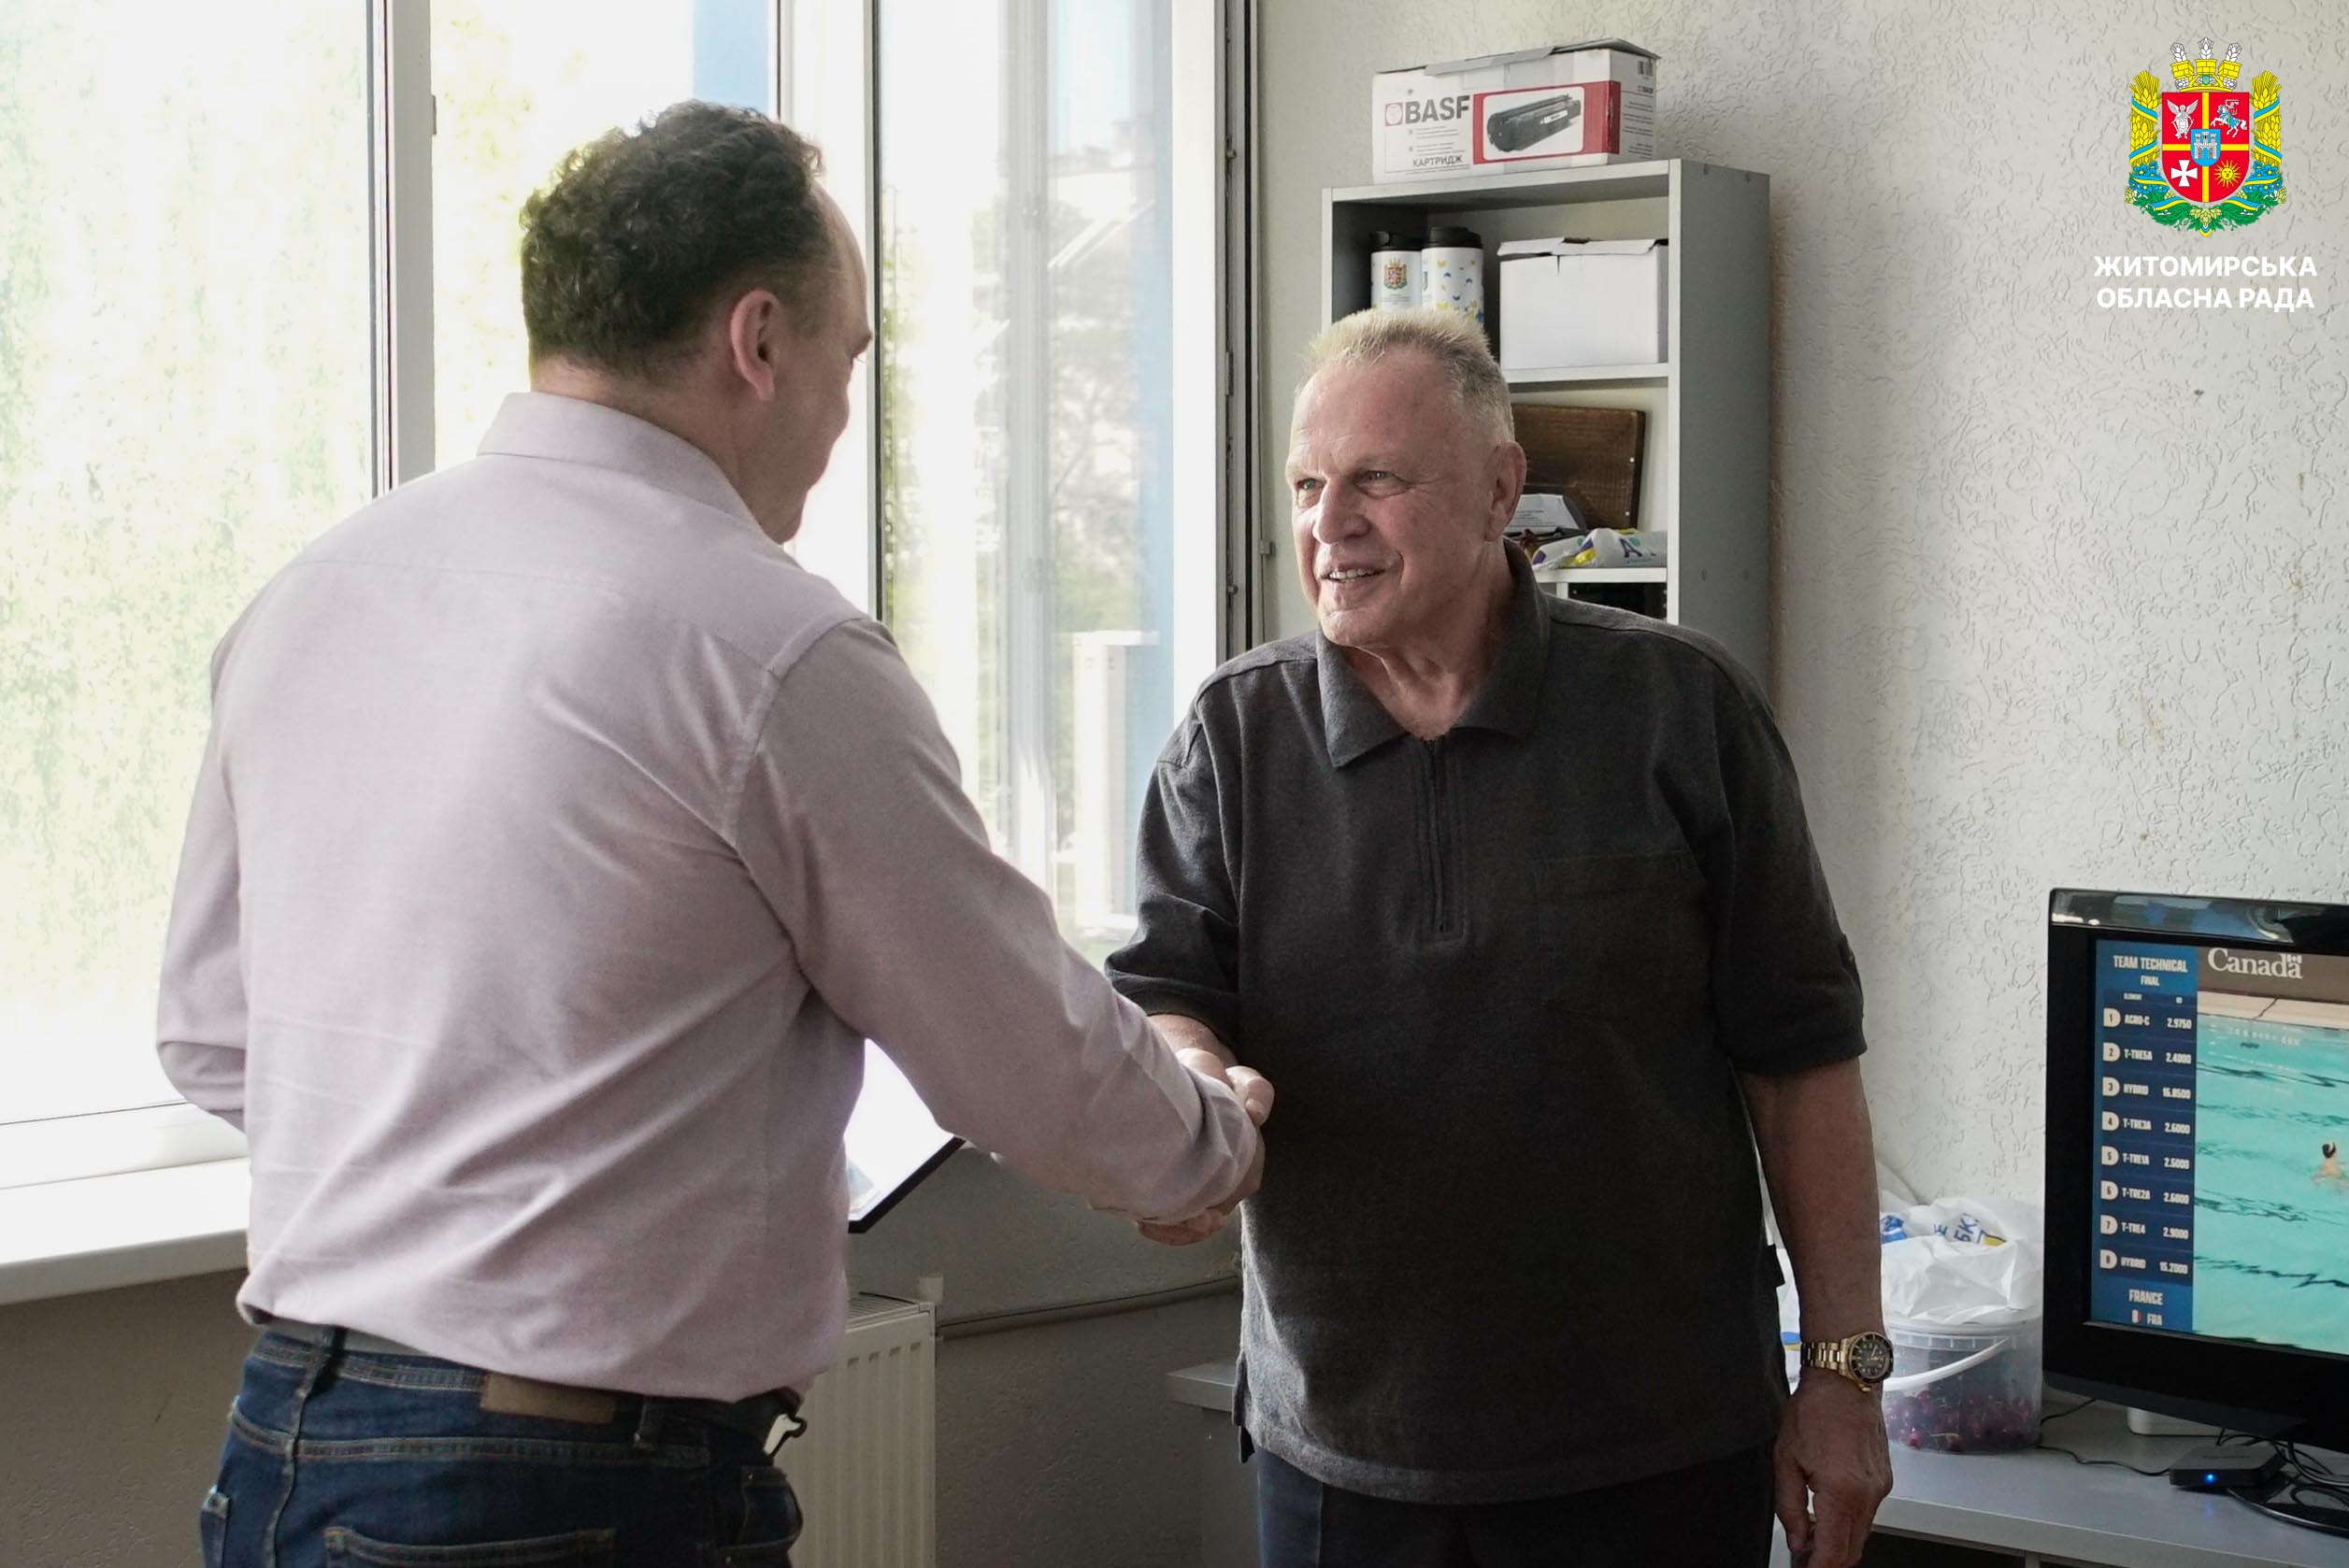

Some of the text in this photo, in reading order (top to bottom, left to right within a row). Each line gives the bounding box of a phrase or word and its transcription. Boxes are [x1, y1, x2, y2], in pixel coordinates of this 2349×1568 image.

[1405, 94, 1470, 124] BASF
[1412, 154, 1464, 167] КАРТРИДЖ
[2113, 955, 2188, 973] TEAM TECHNICAL
[2207, 947, 2304, 979] Canada
[2128, 1289, 2164, 1305] FRANCE
[2147, 1313, 2163, 1326] FRA
